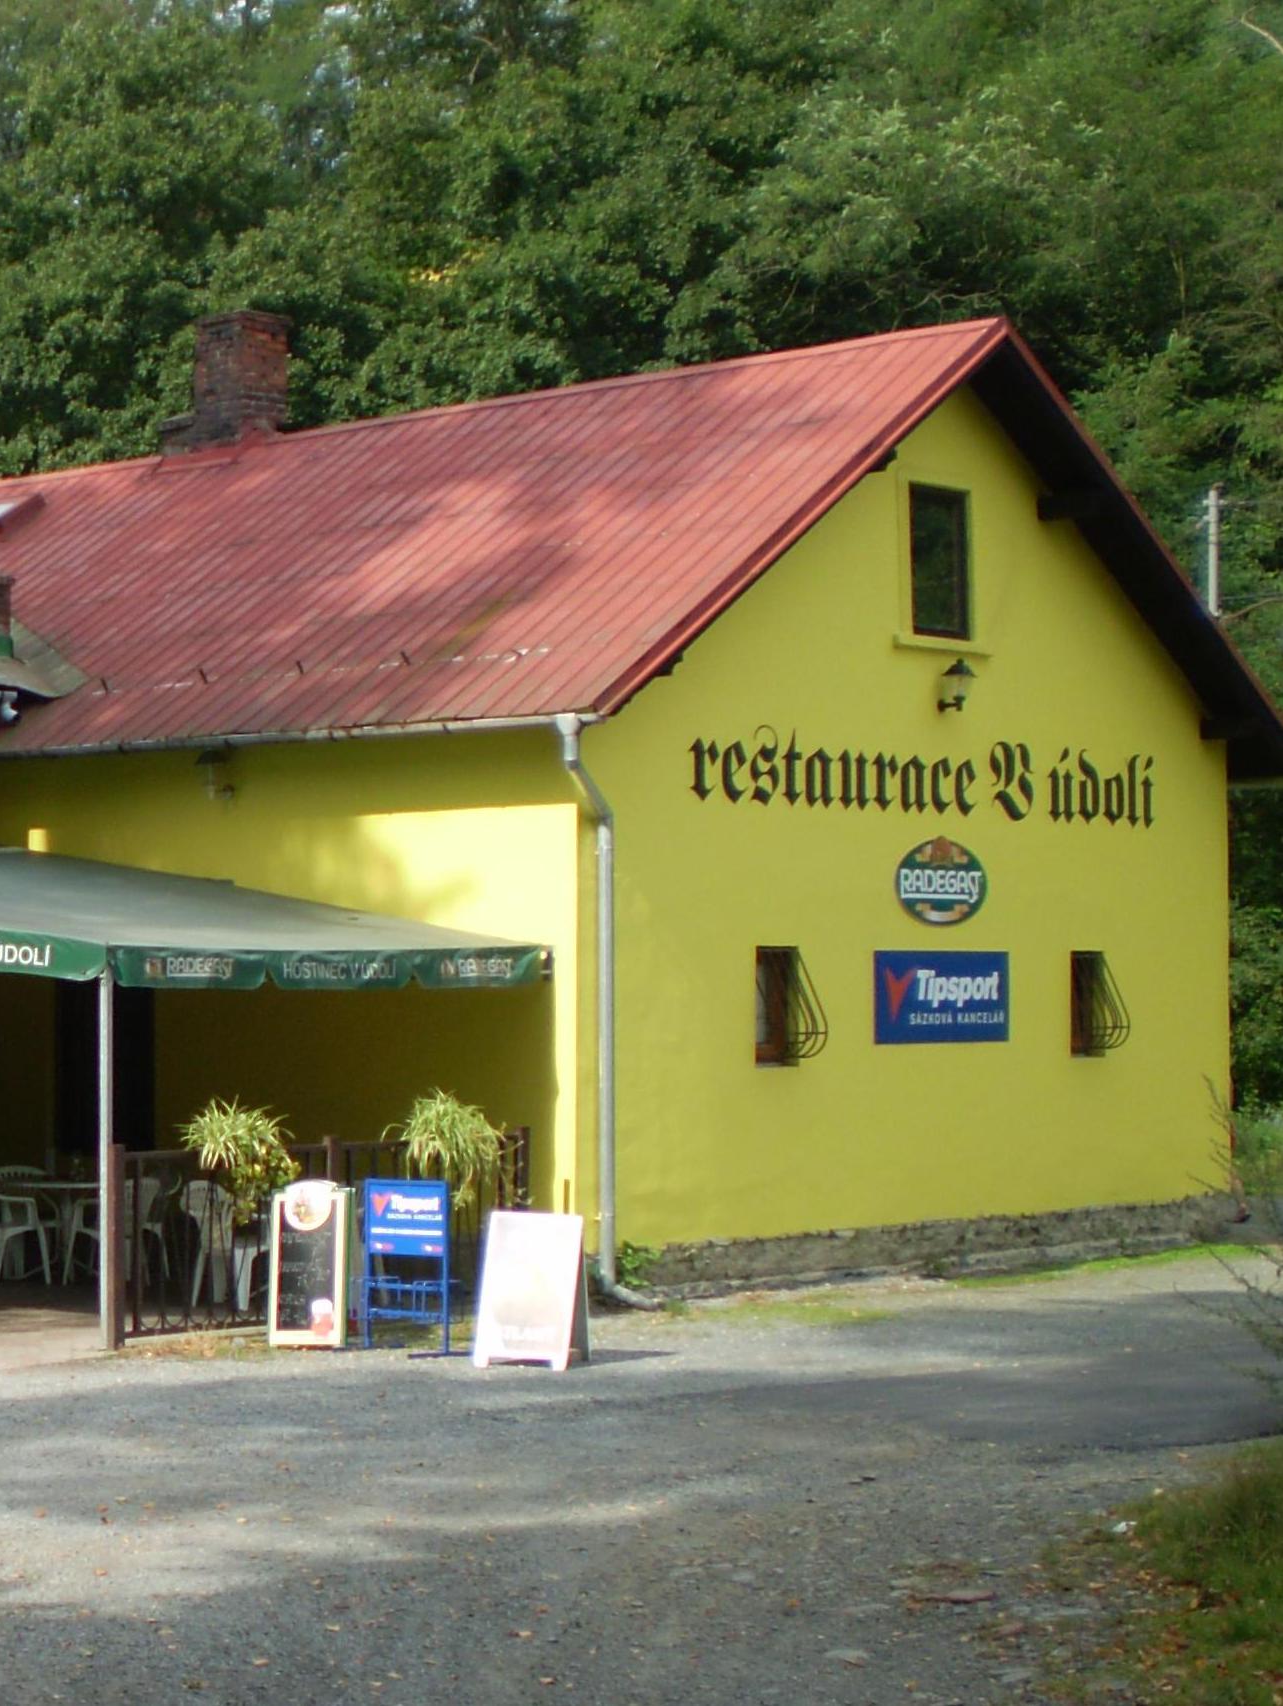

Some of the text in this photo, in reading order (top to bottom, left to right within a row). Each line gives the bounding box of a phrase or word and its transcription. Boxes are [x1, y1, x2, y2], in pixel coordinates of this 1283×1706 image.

[689, 725, 976, 817] restaurace
[1047, 747, 1155, 829] údolí
[900, 868, 983, 904] RADEGAST
[917, 969, 999, 1009] Tipsport
